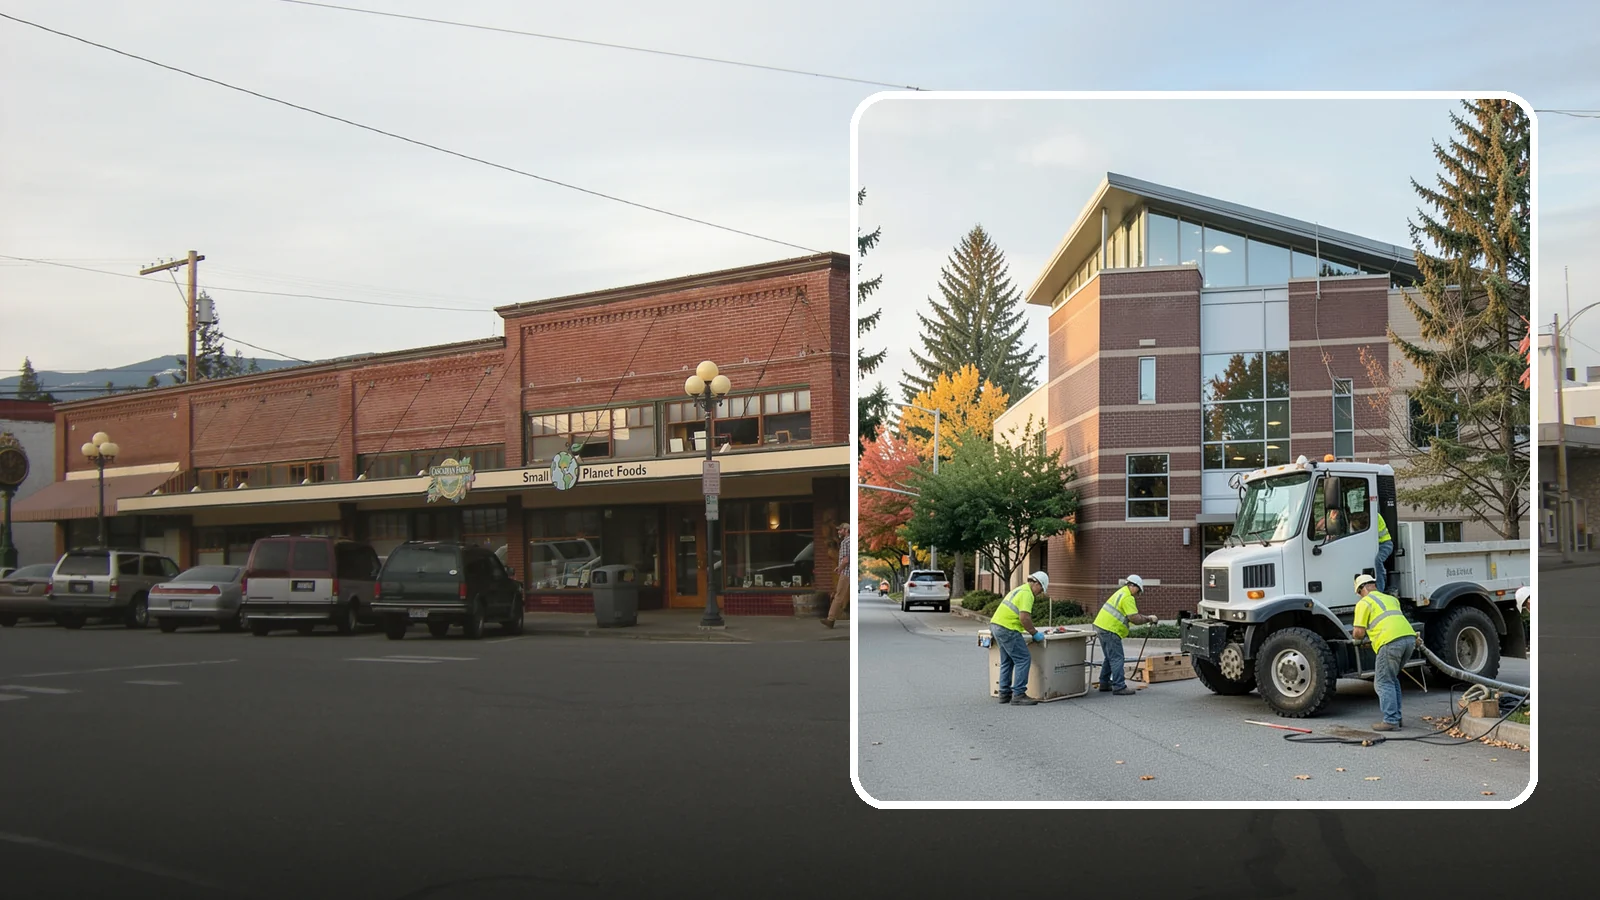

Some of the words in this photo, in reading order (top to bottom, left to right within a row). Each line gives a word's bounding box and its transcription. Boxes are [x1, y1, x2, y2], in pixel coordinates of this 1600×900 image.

[523, 471, 549, 483] Small
[582, 467, 614, 479] Planet
[616, 464, 647, 477] Foods
